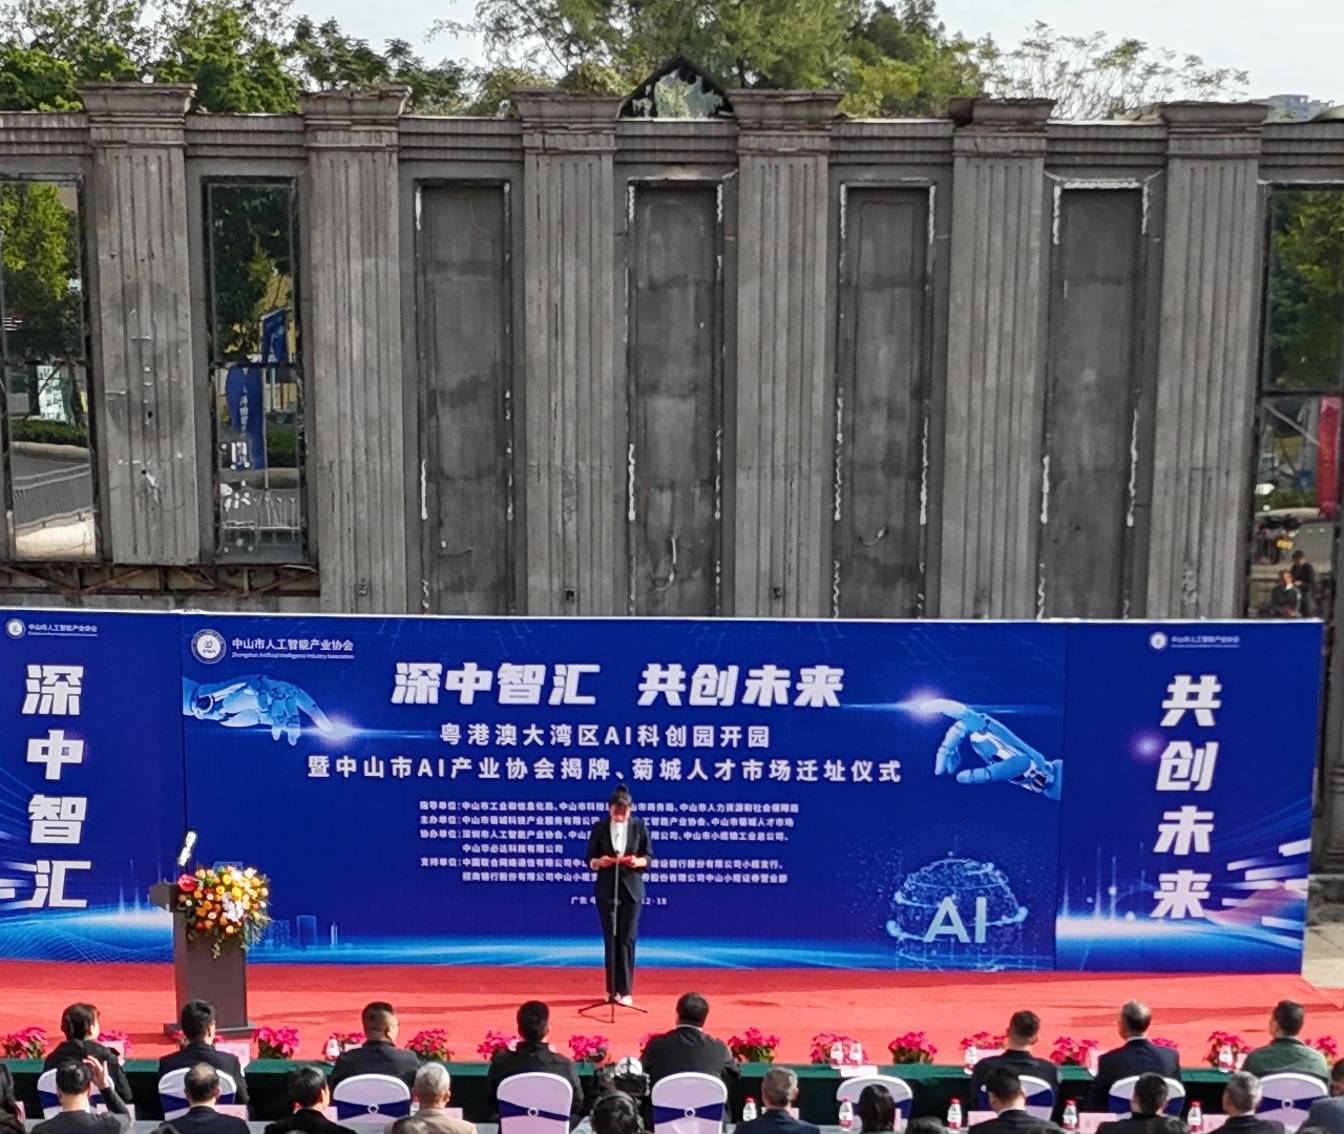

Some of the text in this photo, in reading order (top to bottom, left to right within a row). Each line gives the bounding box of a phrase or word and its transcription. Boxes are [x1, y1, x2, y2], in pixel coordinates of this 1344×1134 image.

[232, 637, 354, 652] 中山市人工智能产业协会
[391, 662, 845, 708] 深中智汇 共创未来
[439, 723, 770, 748] 粤港澳大湾区AI科创园开园
[22, 664, 92, 908] 深中智汇
[1150, 675, 1222, 919] 共创未来
[922, 896, 988, 944] AI
